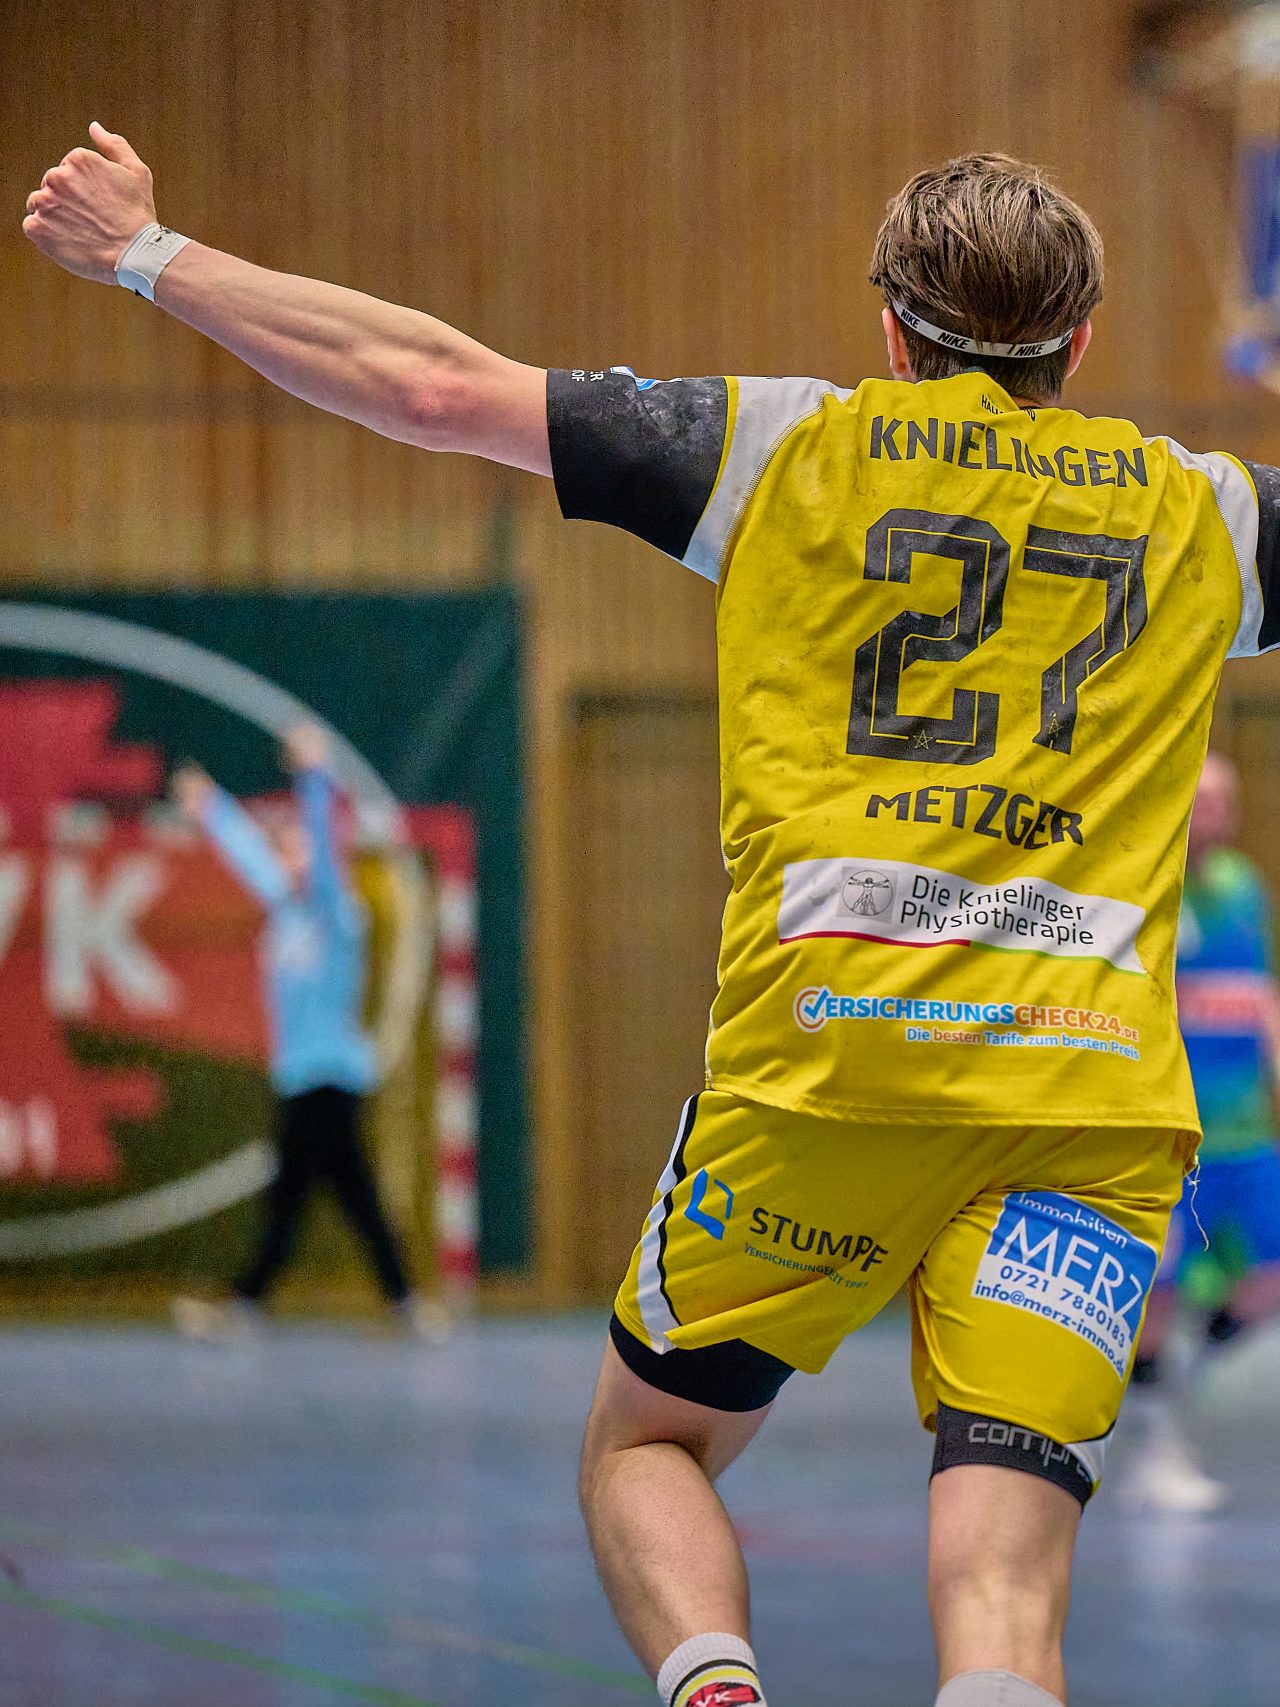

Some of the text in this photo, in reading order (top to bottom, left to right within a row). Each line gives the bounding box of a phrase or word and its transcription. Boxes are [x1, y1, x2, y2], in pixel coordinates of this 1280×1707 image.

[900, 308, 921, 329] NIKE
[936, 331, 971, 351] NIKE
[1014, 343, 1046, 357] NIKE
[868, 414, 1150, 488] KNIELINGEN
[845, 507, 1150, 766] 27
[865, 783, 1084, 850] METZGER
[900, 900, 1095, 946] Physiotherapie
[911, 875, 1085, 922] Die Knielinger
[906, 1027, 1140, 1061] Die besten Tarife zum besten Preis
[749, 1206, 889, 1272] STUMPF
[1018, 1193, 1128, 1249] Immobilien
[996, 1215, 1143, 1318] MERZ
[999, 1265, 1127, 1348] 0721 7880183
